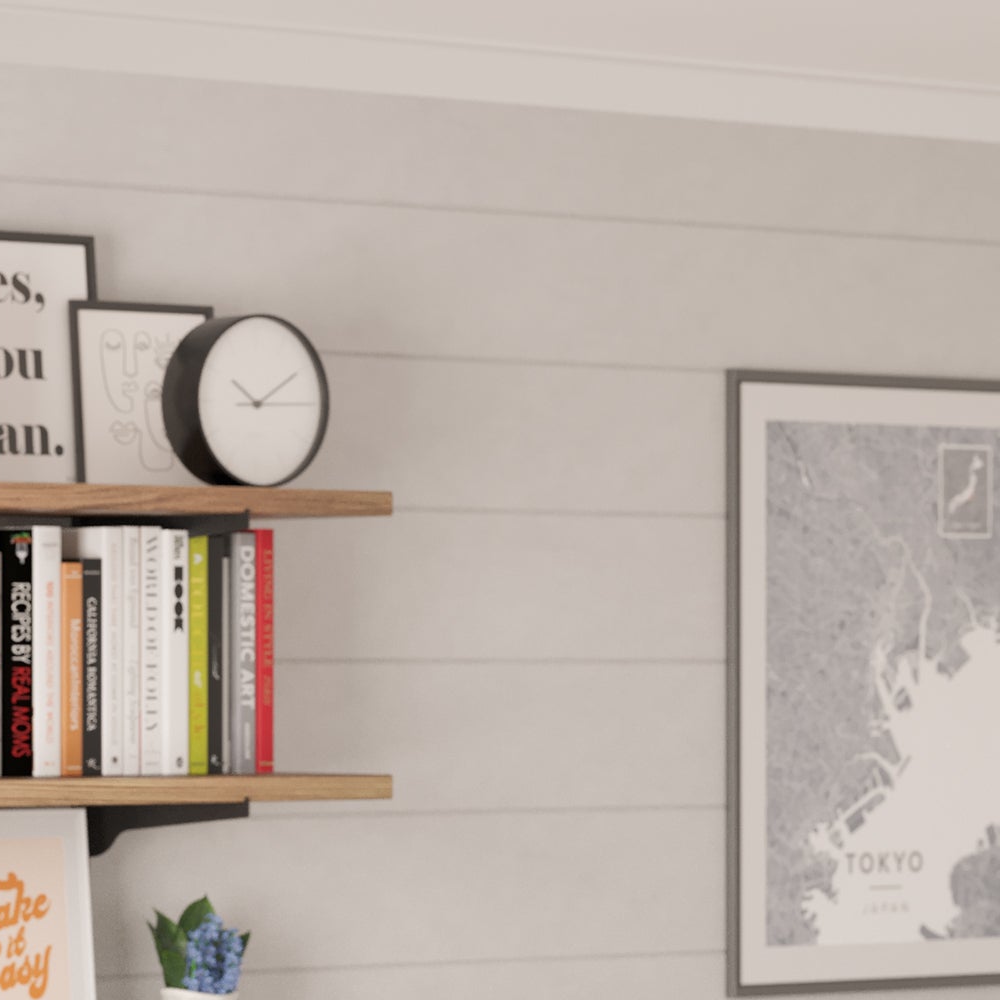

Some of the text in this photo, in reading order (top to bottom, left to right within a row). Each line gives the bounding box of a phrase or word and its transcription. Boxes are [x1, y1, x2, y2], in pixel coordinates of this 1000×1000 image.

[87, 597, 98, 666] CALIFORNIA
[239, 545, 256, 711] DOMESTIC ART
[10, 581, 32, 758] RECIPES BY REAL MOMS
[844, 851, 924, 874] TOKYO
[7, 926, 27, 958] it
